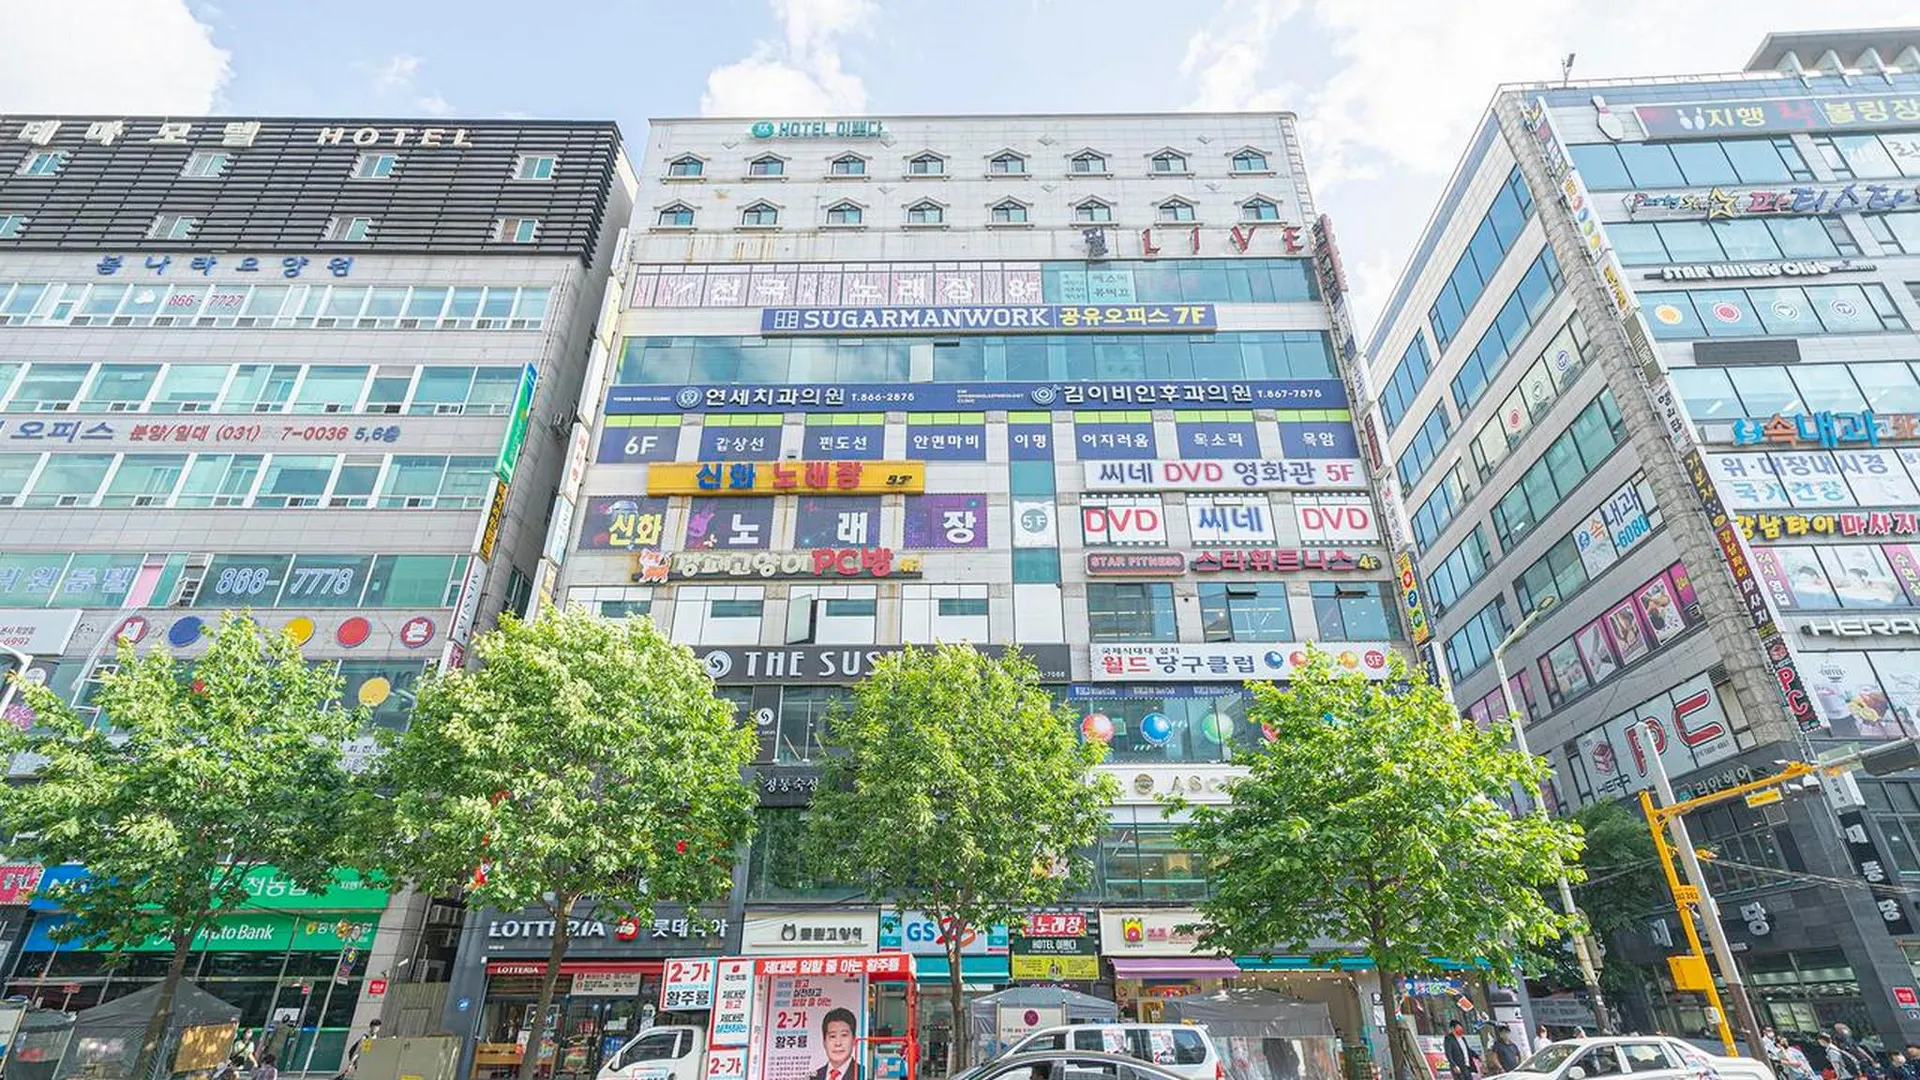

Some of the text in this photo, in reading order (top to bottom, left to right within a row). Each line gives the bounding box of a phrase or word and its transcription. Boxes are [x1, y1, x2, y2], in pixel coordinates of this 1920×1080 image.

[1708, 108, 1764, 128] 지행
[317, 126, 473, 147] HOTEL
[779, 121, 830, 137] HOTEL
[1142, 226, 1304, 255] LIVE
[1661, 261, 1831, 281] STAR Billiard Club
[803, 305, 1206, 329] SUGARMANWORK 공유오피스 7F
[705, 387, 845, 407] 연세치과의원
[1063, 384, 1252, 404] 김이비인후과의원
[9, 420, 114, 443] 오피스
[215, 424, 261, 443] (031)
[1014, 433, 1047, 449] 이명
[1082, 432, 1149, 449] 어지러움
[1193, 432, 1244, 448] 목소리
[624, 435, 659, 456] 6F
[912, 434, 979, 451] 안면마비
[696, 462, 756, 489] 신화
[1099, 461, 1354, 485] 씨네 DVD 영화관 5F
[608, 511, 664, 546] 신화
[1022, 513, 1046, 530] 5F
[1086, 507, 1159, 533] DVD
[1198, 507, 1263, 533] 씨네
[1303, 506, 1368, 533] DVD
[1840, 511, 1918, 535] 마사지
[1357, 552, 1381, 570] 4F
[1742, 577, 1768, 626] 마사지
[745, 650, 804, 677] THE
[1365, 653, 1384, 667] 3F
[1776, 666, 1809, 716] PC
[1624, 689, 1726, 778] PC
[237, 922, 275, 940] Bank
[496, 965, 540, 974] LOTTERIA
[669, 963, 710, 983] 2-가
[763, 961, 798, 973] 제대로
[776, 1011, 808, 1029] 2-가
[709, 1057, 741, 1074] 2-가
